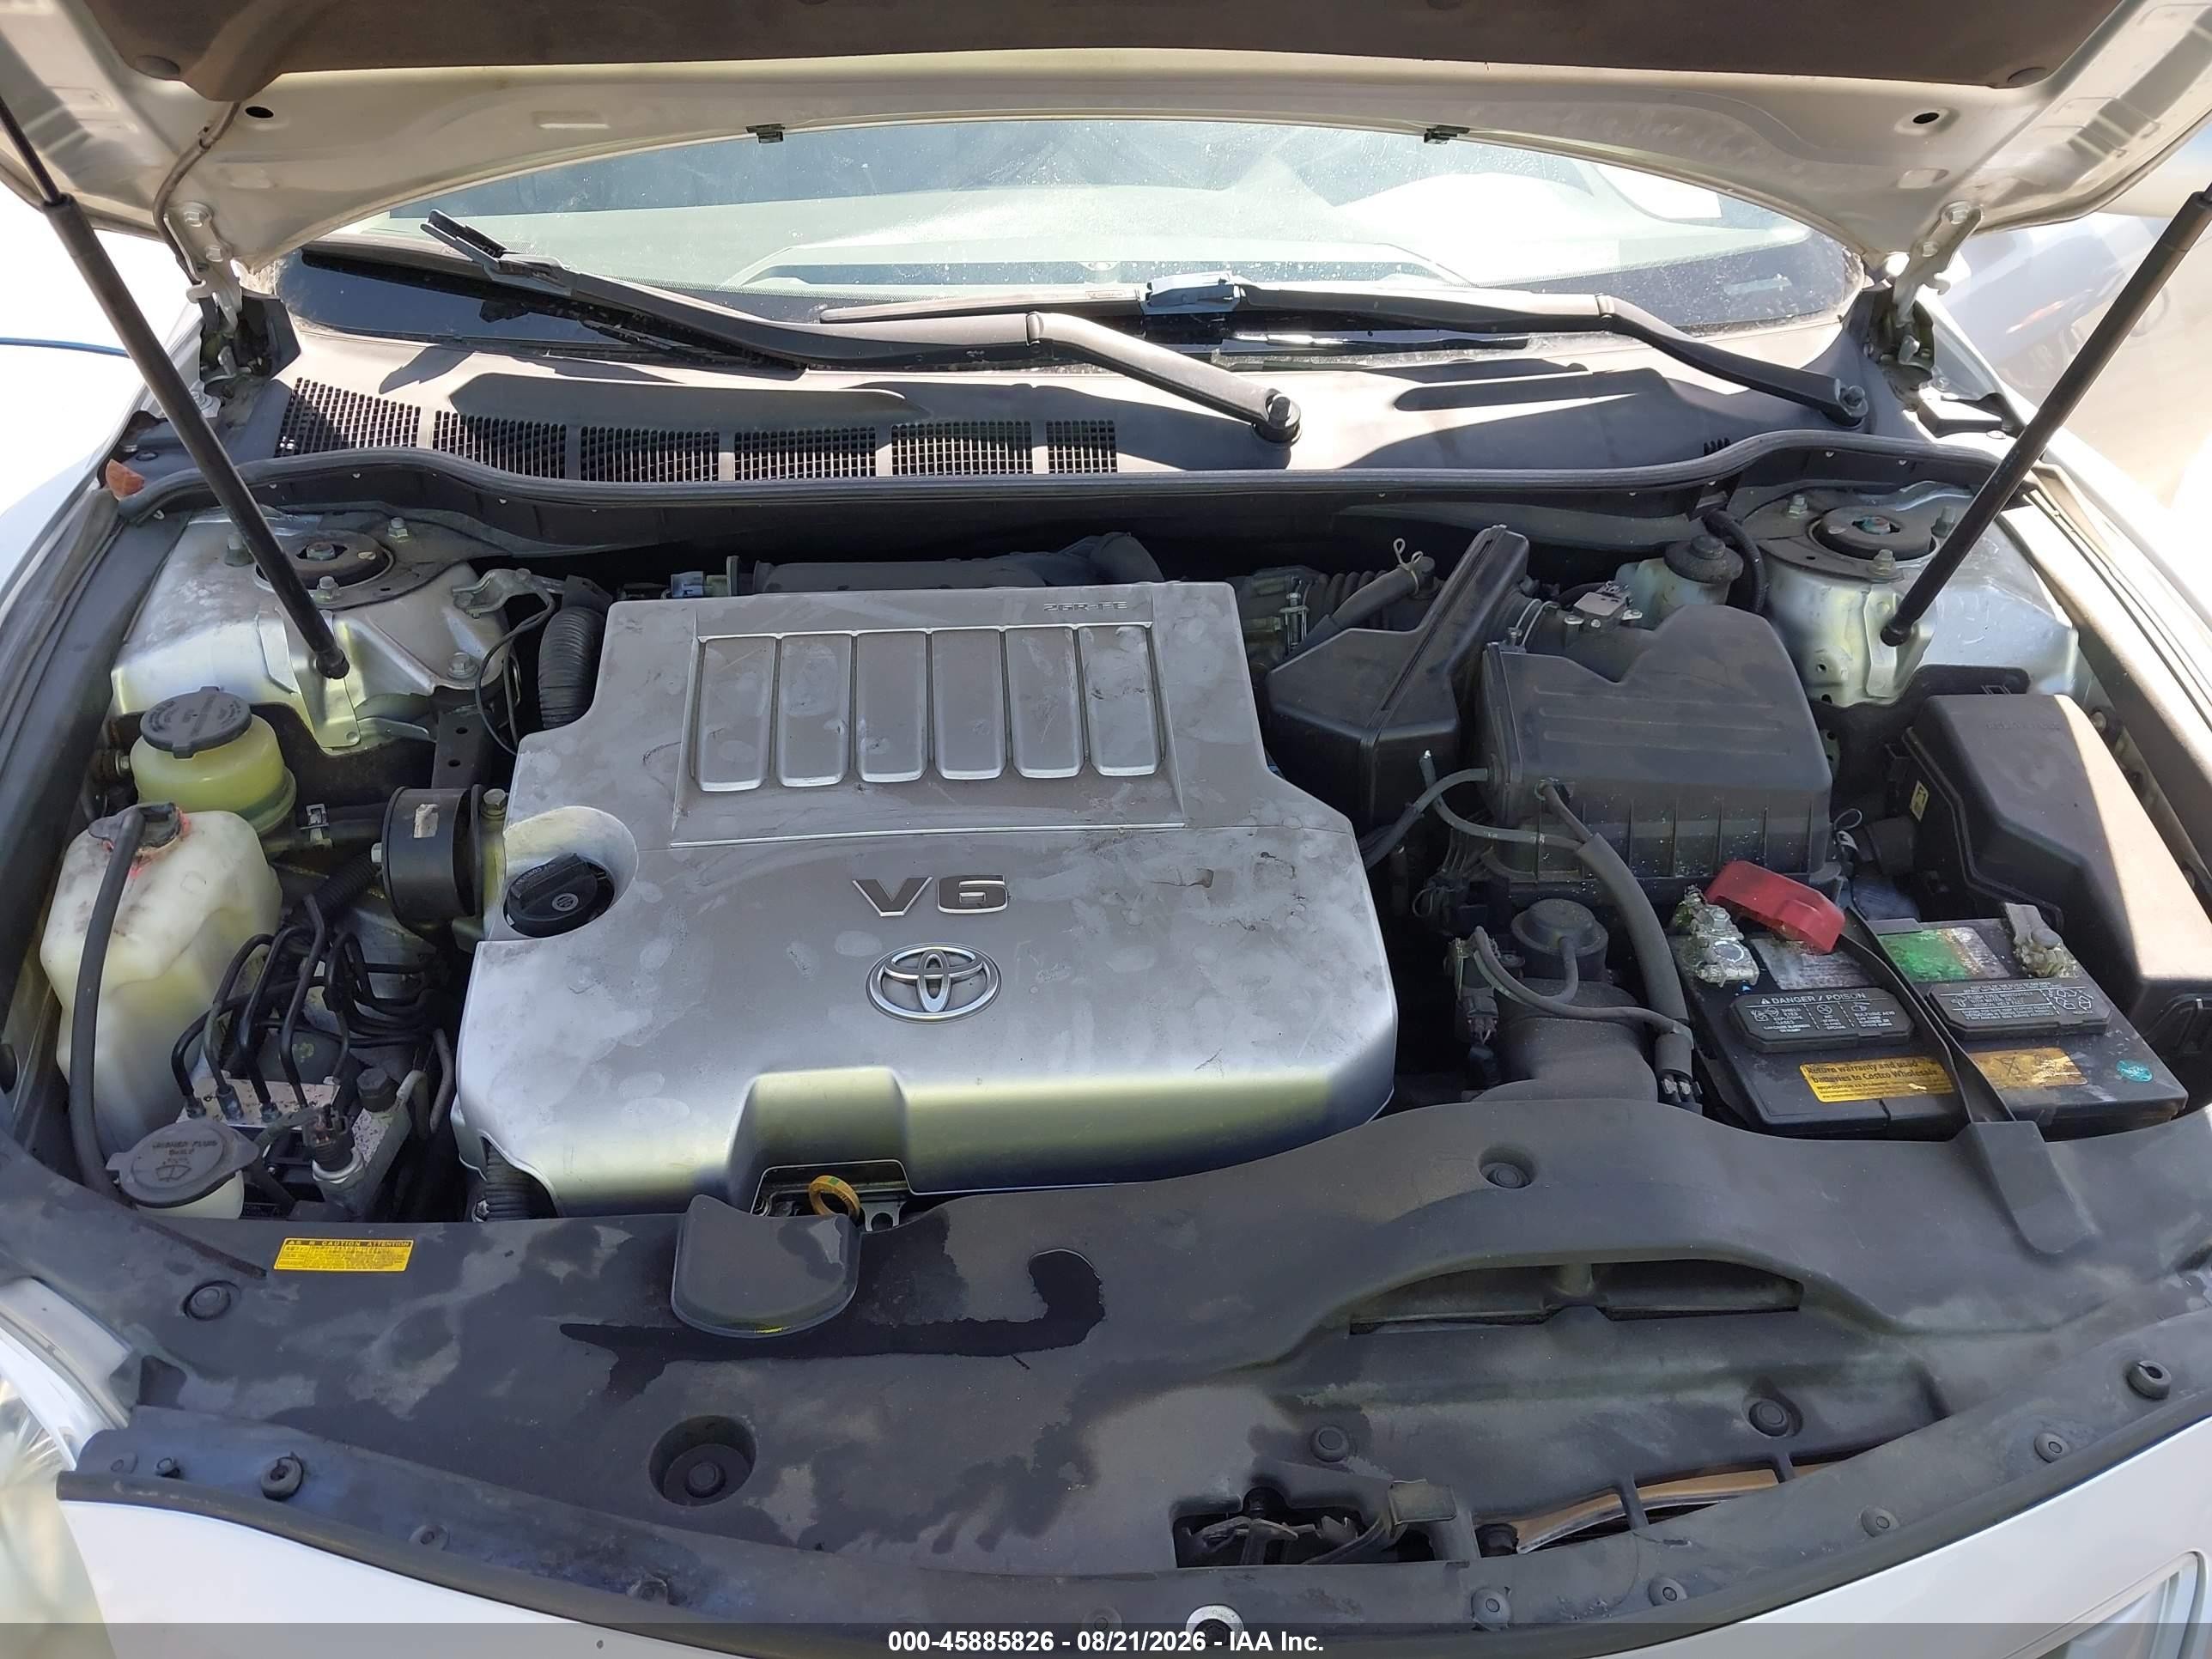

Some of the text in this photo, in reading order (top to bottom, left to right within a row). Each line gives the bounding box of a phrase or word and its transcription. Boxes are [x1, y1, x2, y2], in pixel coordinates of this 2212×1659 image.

[1043, 601, 1127, 612] 2GR-FE
[852, 874, 1008, 916] V6
[1771, 995, 1816, 1005] DANGER
[1826, 992, 1867, 1001] POISON
[1806, 1066, 1838, 1074] Return
[1838, 1064, 1878, 1073] warranty
[1896, 1059, 1919, 1067] used
[1862, 1072, 1891, 1080] Costco
[1891, 1068, 1939, 1078] Wholesale
